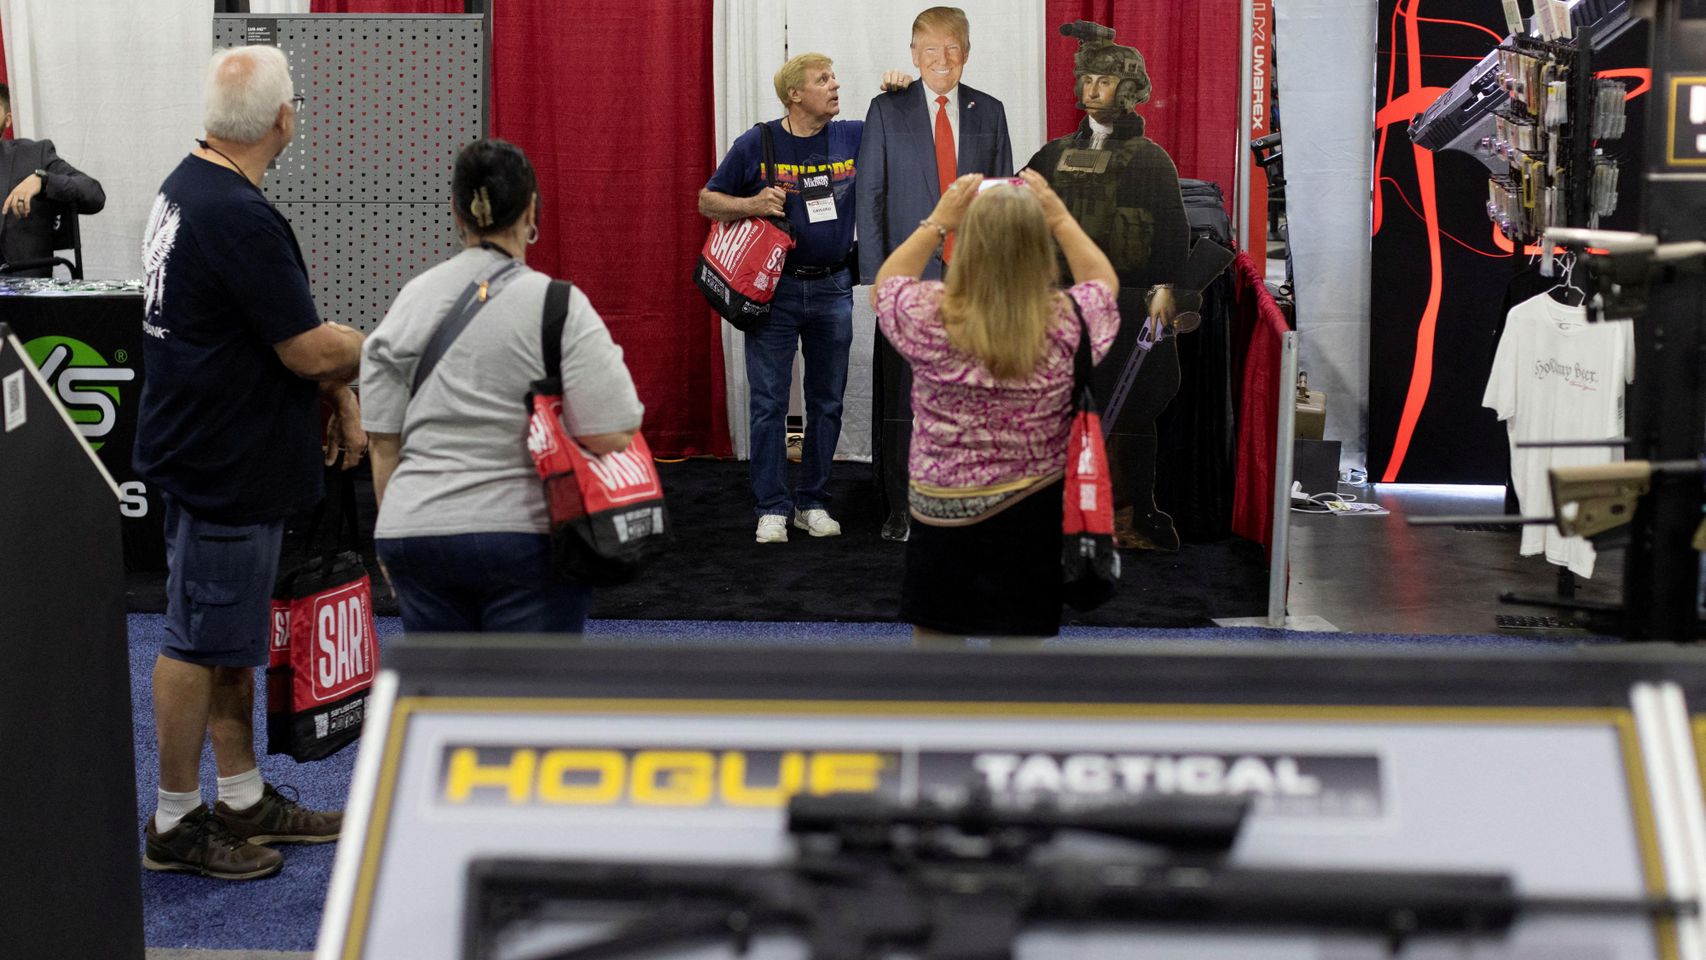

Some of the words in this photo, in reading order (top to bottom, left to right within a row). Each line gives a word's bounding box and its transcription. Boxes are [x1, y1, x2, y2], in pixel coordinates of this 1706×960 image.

[1253, 45, 1265, 129] UMAREX
[710, 219, 753, 272] SAR
[318, 596, 363, 688] SAR
[446, 747, 886, 807] HOGUE
[972, 752, 1321, 796] TACTICAL
